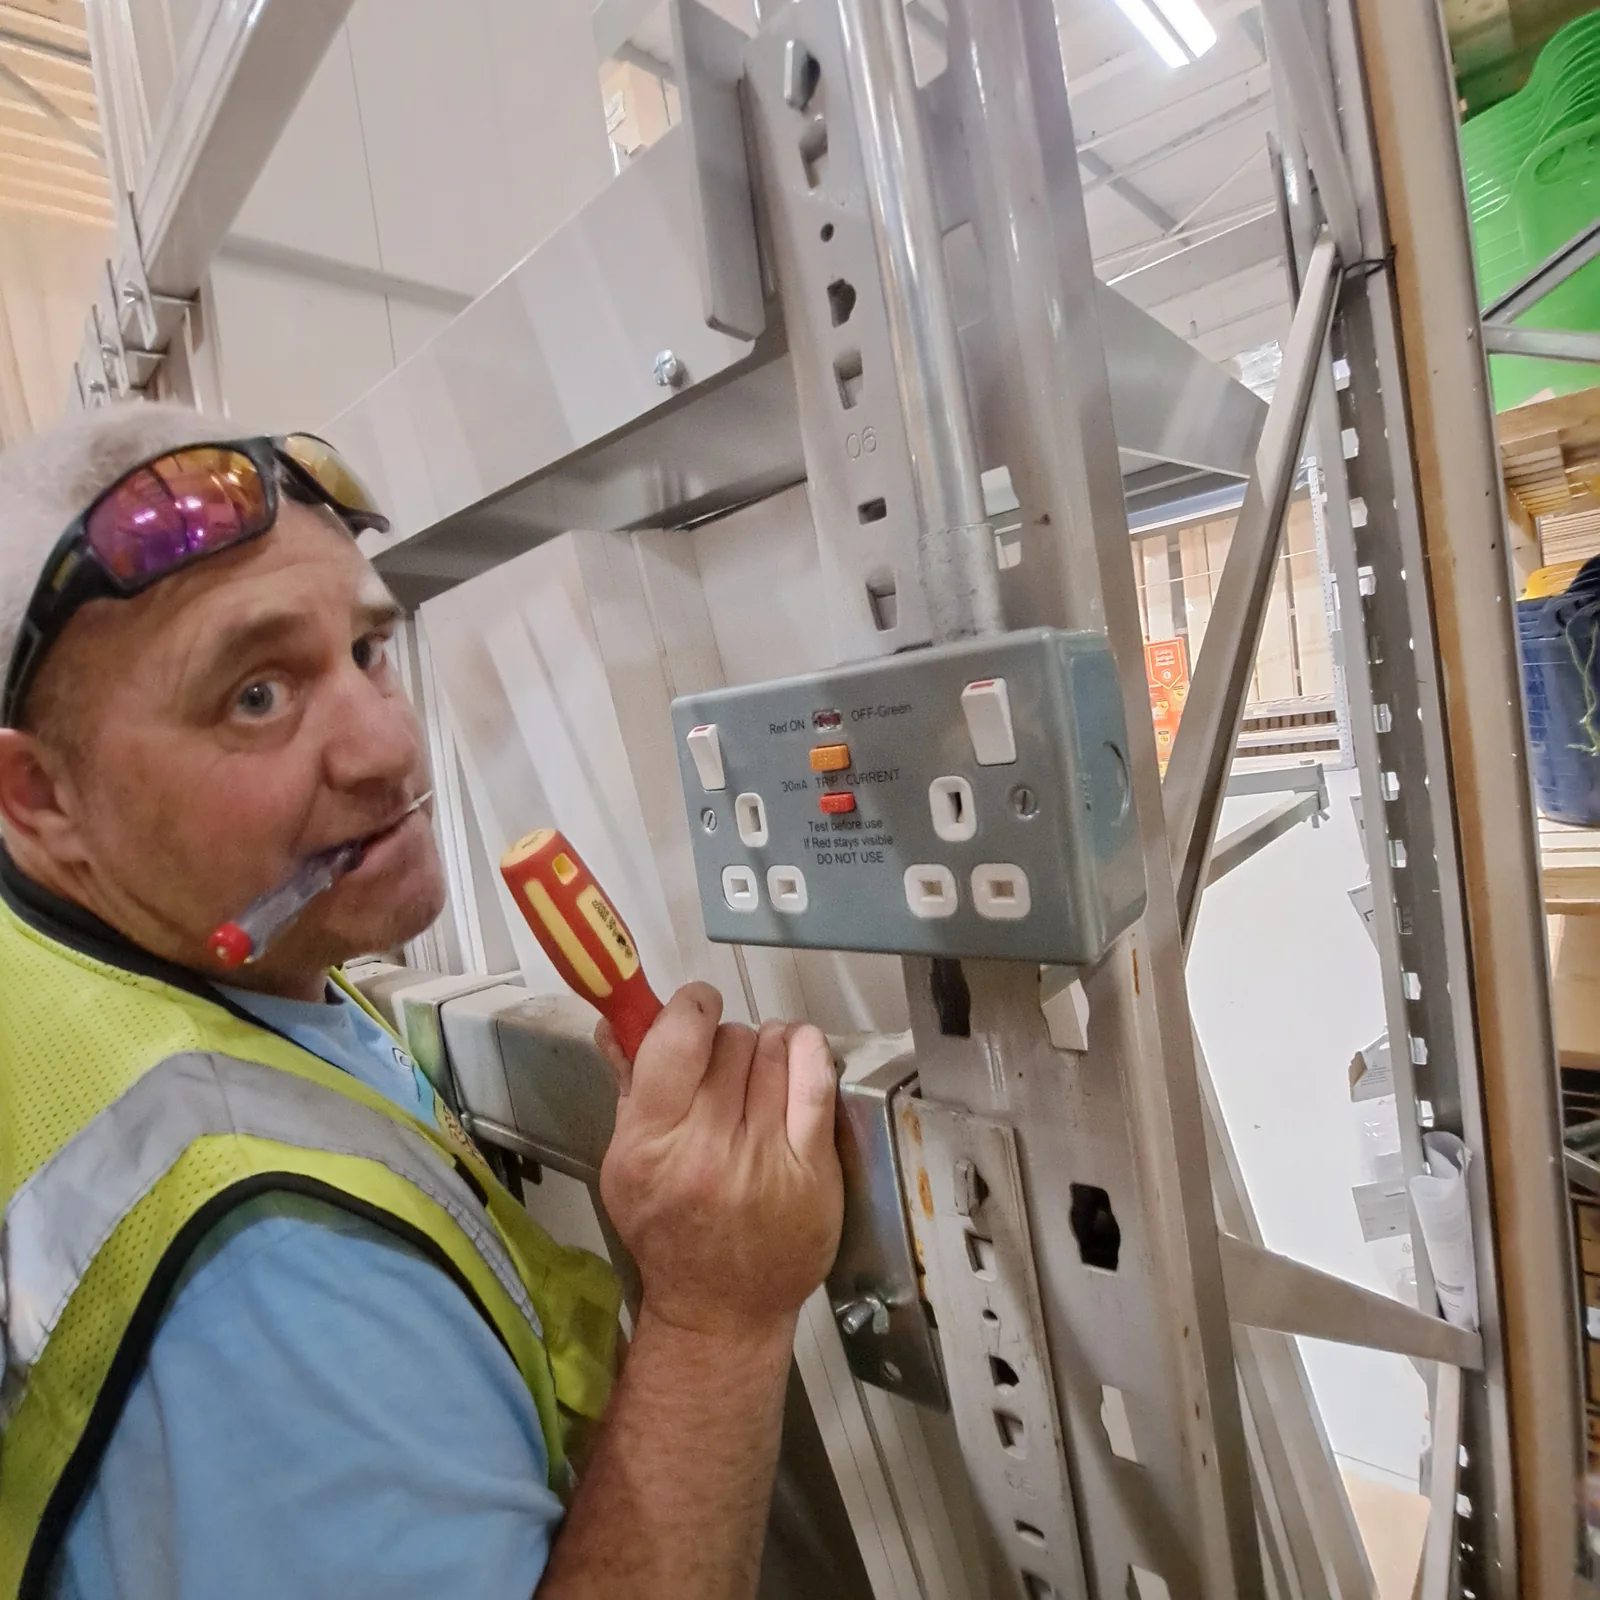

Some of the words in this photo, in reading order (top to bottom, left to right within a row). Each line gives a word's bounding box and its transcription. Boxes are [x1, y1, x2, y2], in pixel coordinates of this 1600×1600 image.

[845, 425, 877, 461] 06
[769, 723, 788, 735] Red
[789, 720, 805, 732] ON
[781, 779, 808, 792] 30mA
[846, 768, 900, 786] CURRENT
[808, 820, 829, 833] Test
[831, 819, 861, 832] before
[864, 819, 884, 830] use
[812, 837, 831, 849] Red
[833, 837, 859, 850] stays
[862, 834, 894, 847] visible
[816, 853, 833, 865] DO
[834, 852, 858, 864] NOT
[860, 851, 885, 864] USE
